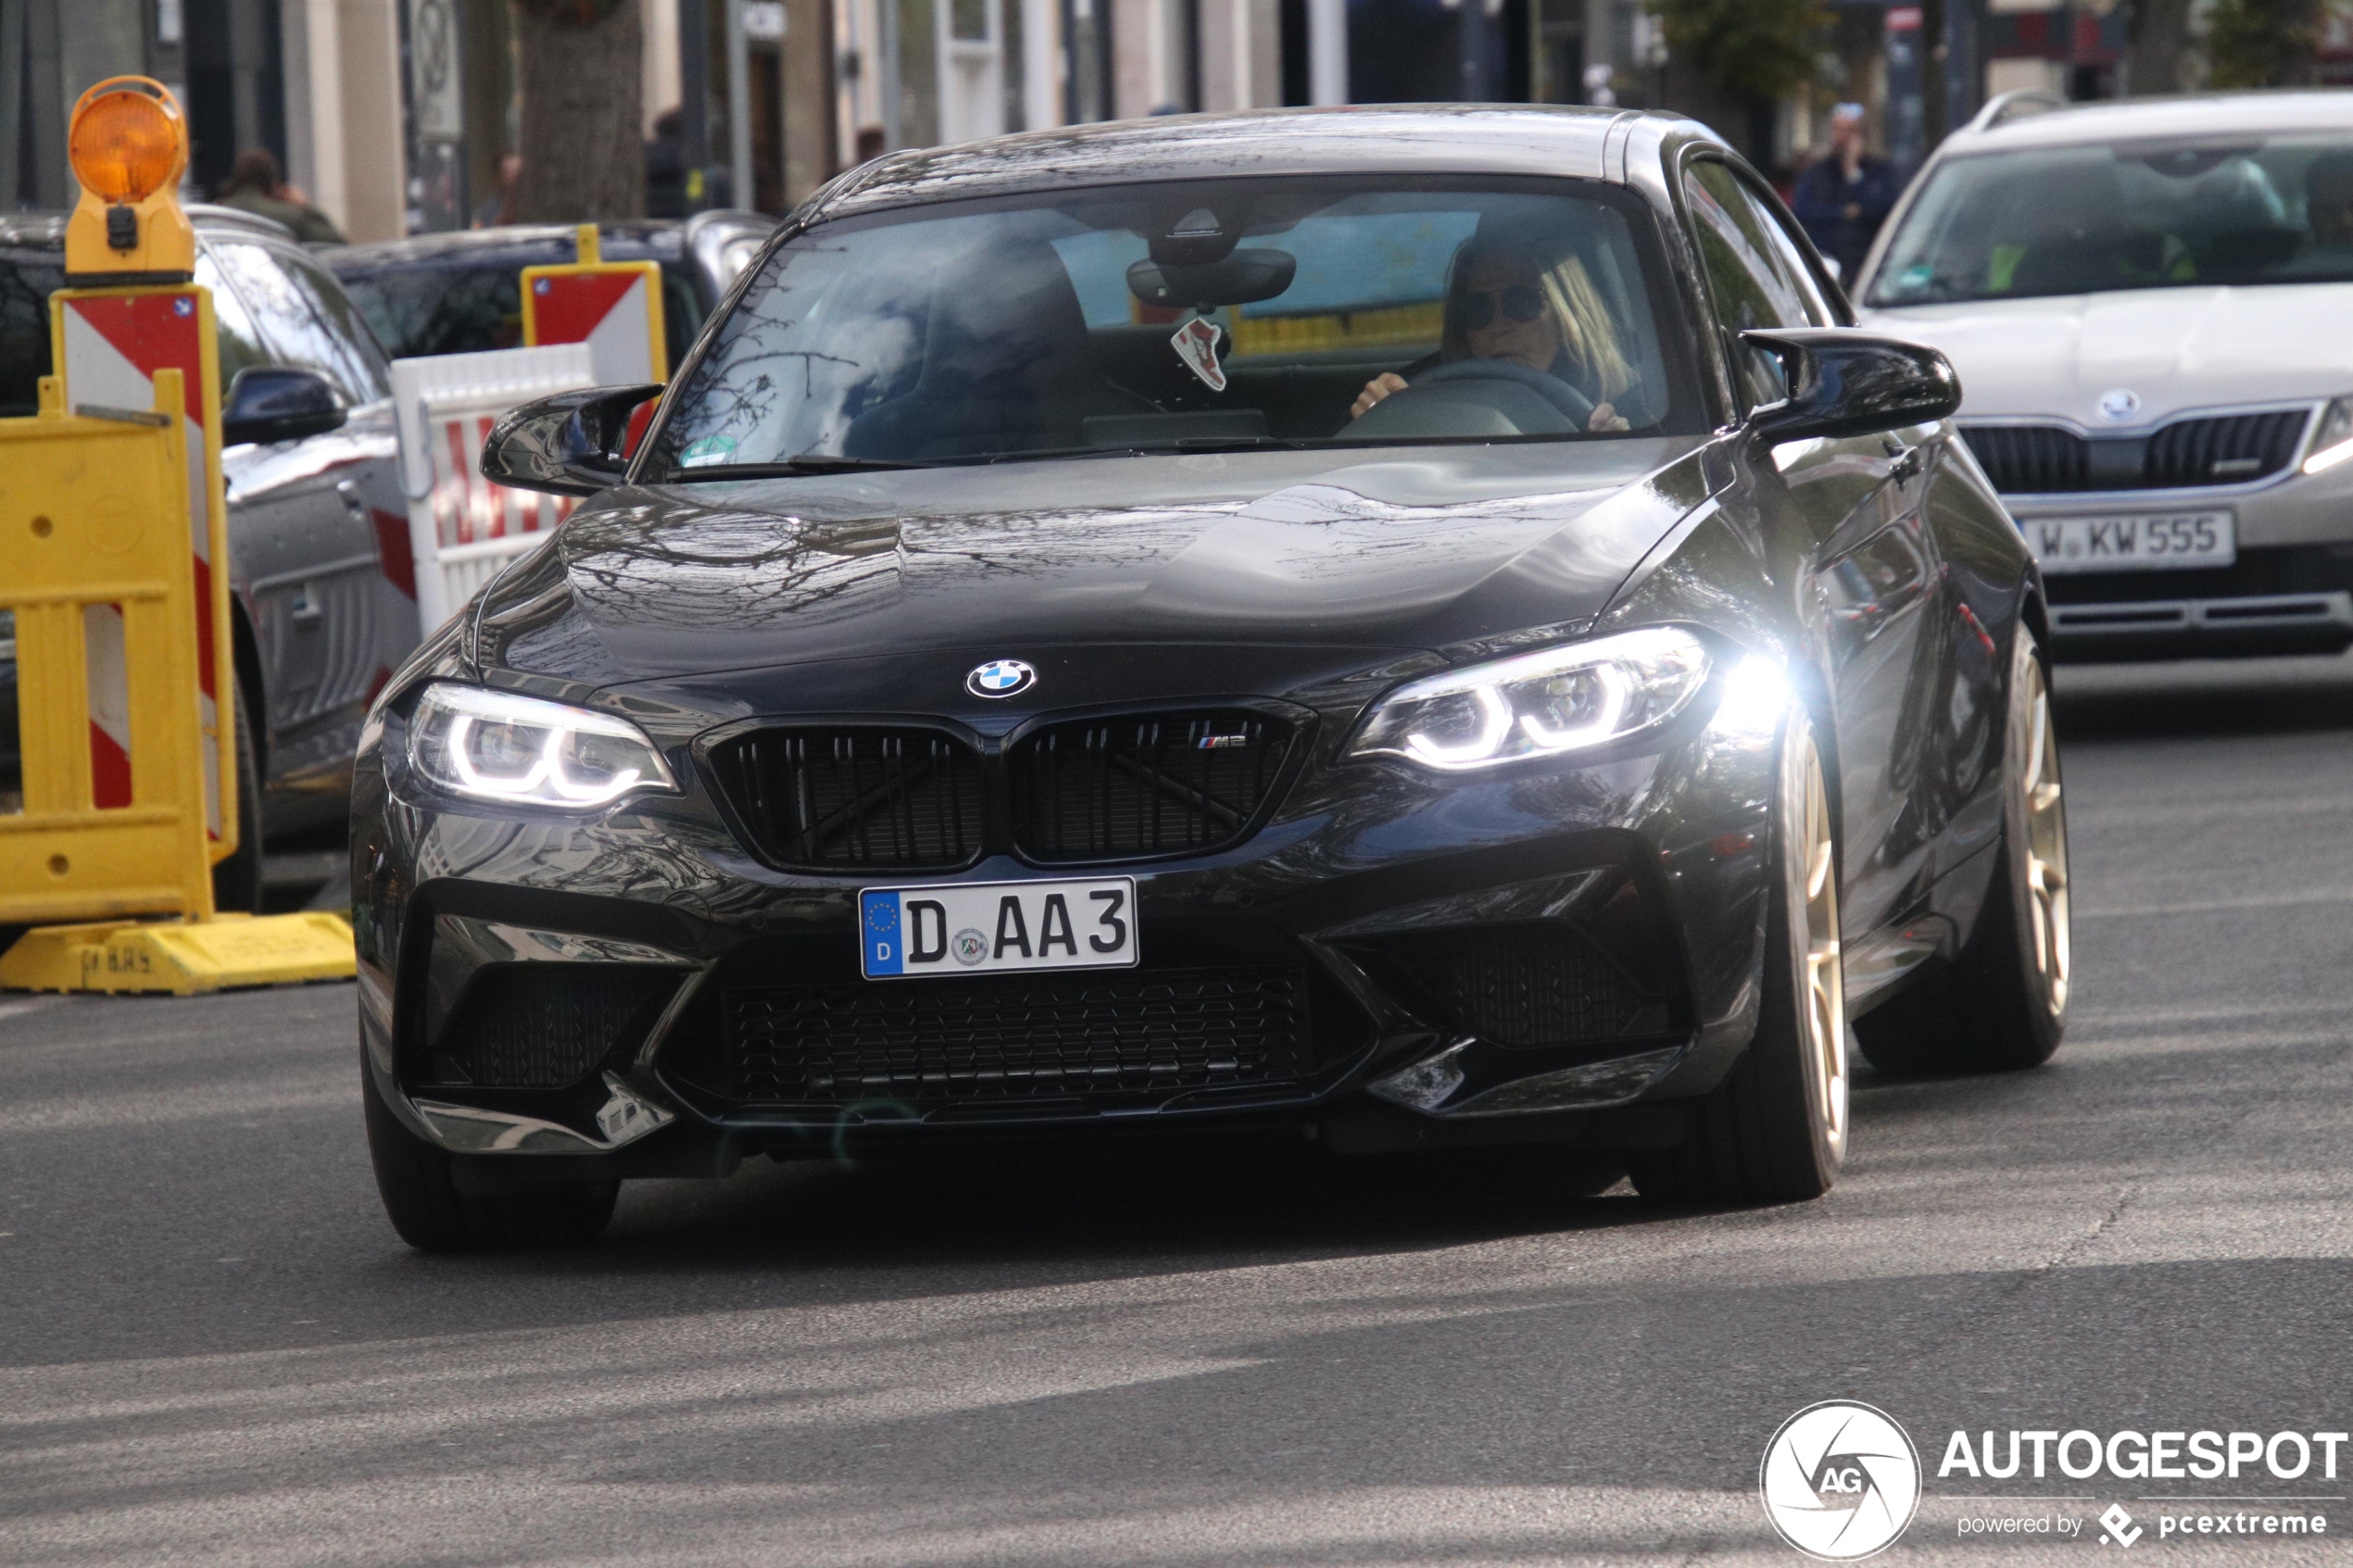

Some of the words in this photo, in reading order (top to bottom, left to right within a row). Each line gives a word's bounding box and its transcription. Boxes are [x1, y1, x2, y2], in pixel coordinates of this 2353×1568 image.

[2041, 524, 2062, 557] W
[975, 660, 1030, 674] BMW
[1213, 735, 1246, 748] M2
[906, 898, 948, 963] D
[876, 943, 891, 961] D
